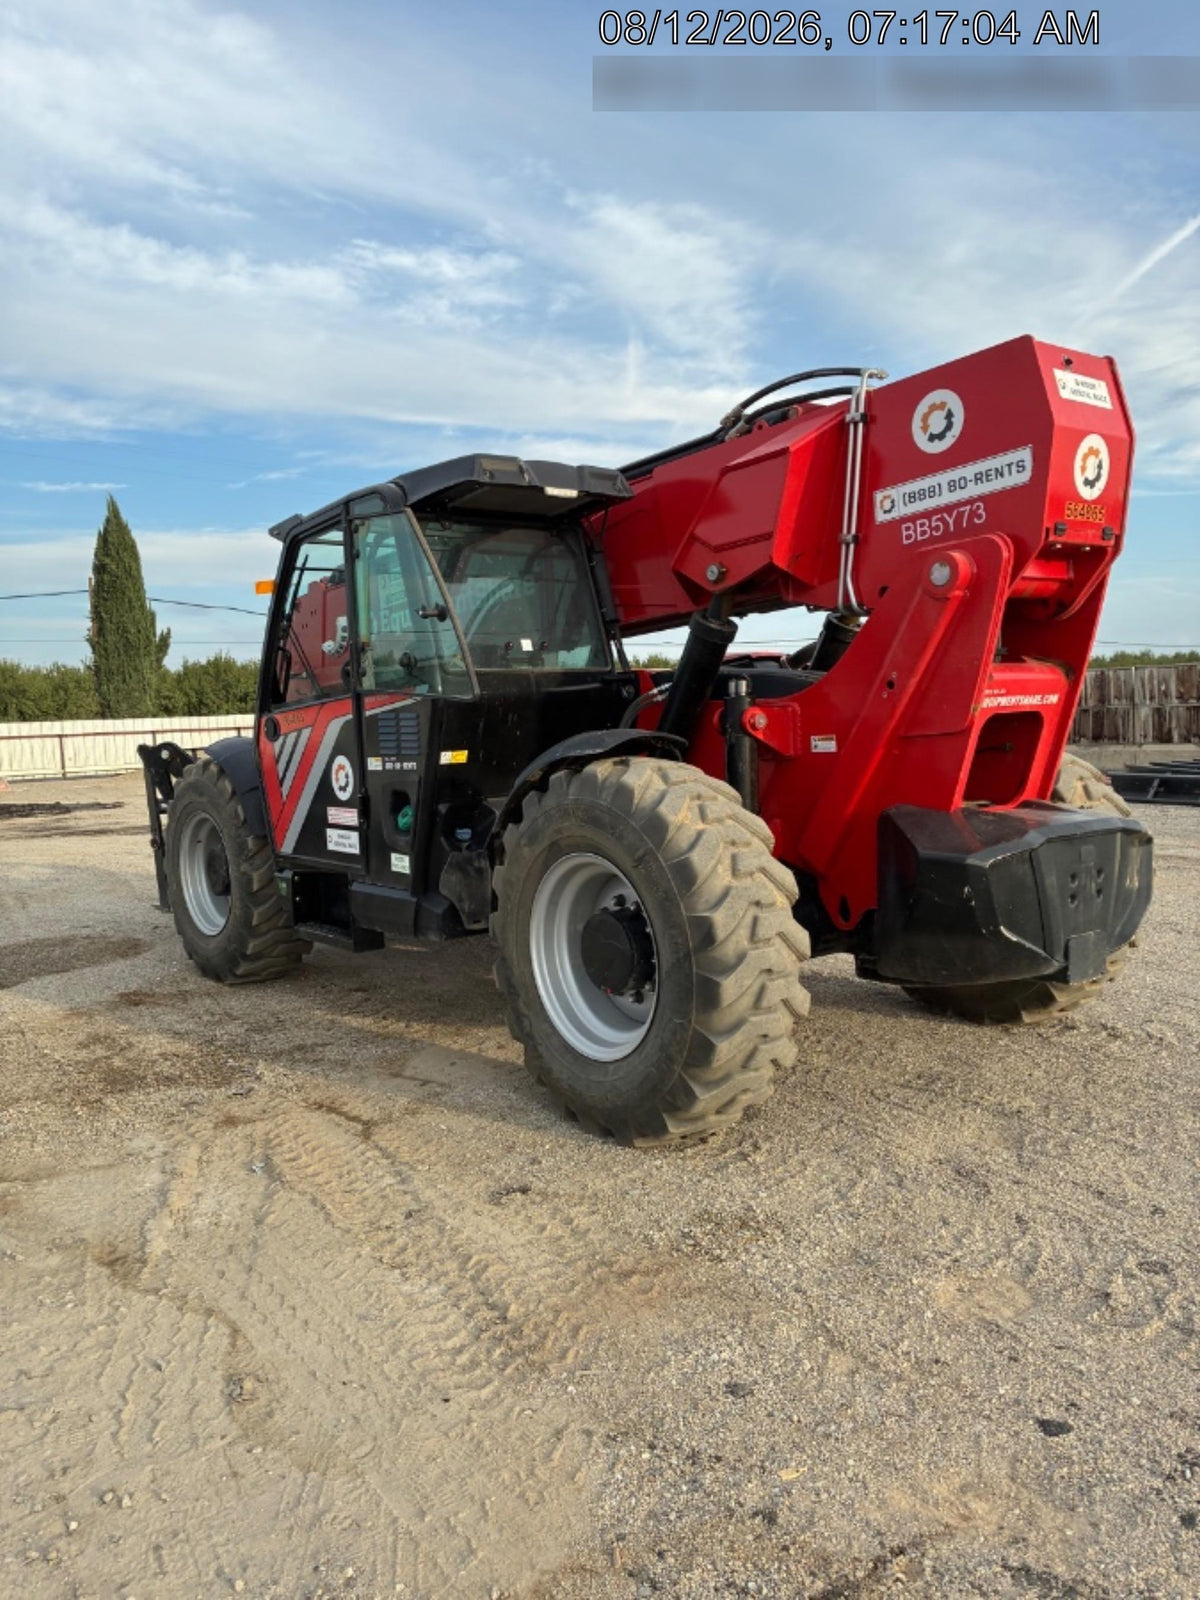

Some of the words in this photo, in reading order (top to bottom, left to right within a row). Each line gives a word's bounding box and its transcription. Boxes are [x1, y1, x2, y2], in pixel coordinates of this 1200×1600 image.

[902, 483, 943, 507] (888)
[947, 459, 1028, 494] 80-RENTS
[901, 502, 987, 545] BB5Y73
